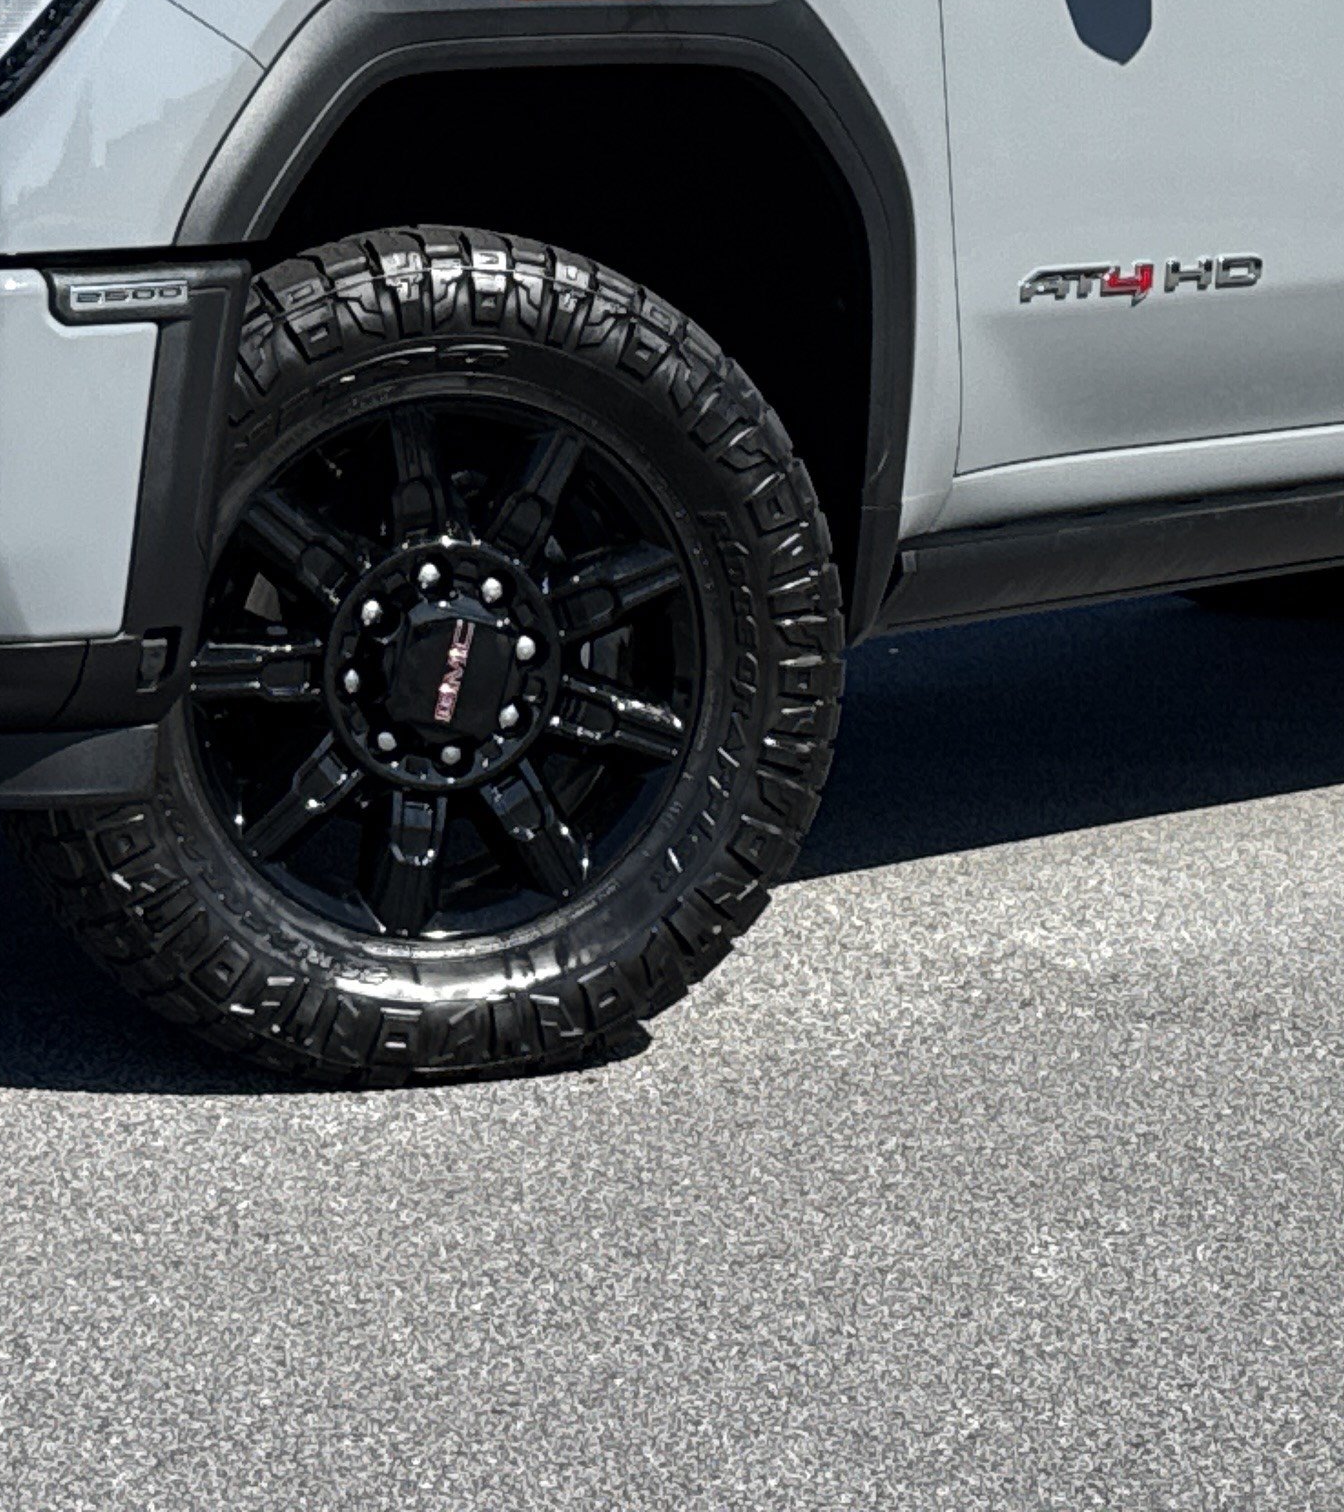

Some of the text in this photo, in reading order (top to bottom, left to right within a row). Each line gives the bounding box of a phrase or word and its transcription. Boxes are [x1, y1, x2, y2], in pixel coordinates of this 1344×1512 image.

[1017, 252, 1263, 308] AT4 HD
[434, 618, 476, 723] GMC
